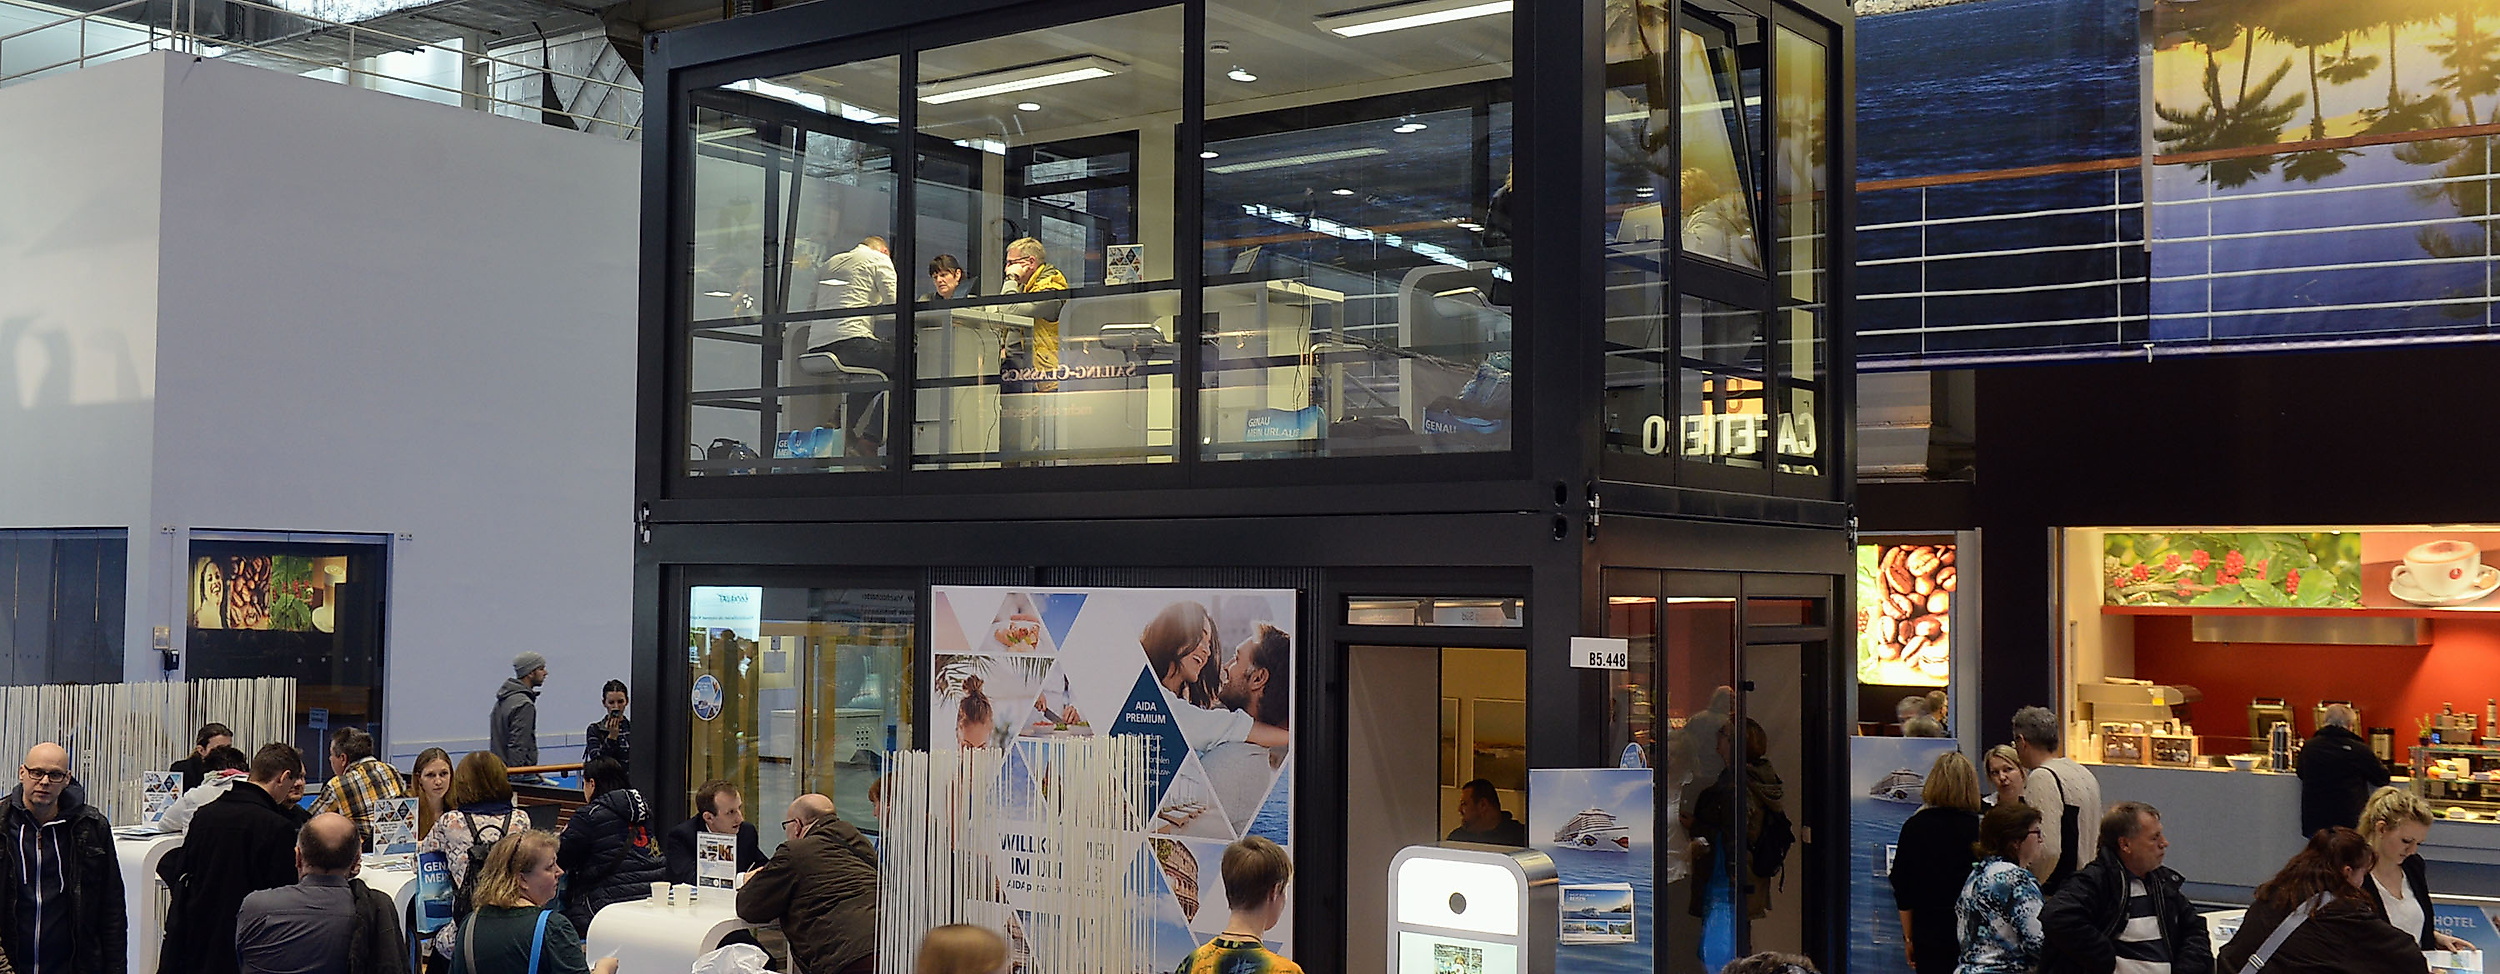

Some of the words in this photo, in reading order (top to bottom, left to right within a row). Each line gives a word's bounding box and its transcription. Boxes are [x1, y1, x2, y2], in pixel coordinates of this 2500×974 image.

[1589, 652, 1626, 667] B5.448
[1135, 701, 1158, 712] AIDA
[1125, 712, 1167, 725] PREMIUM
[1011, 857, 1030, 876] IM
[2433, 915, 2477, 928] HOTEL
